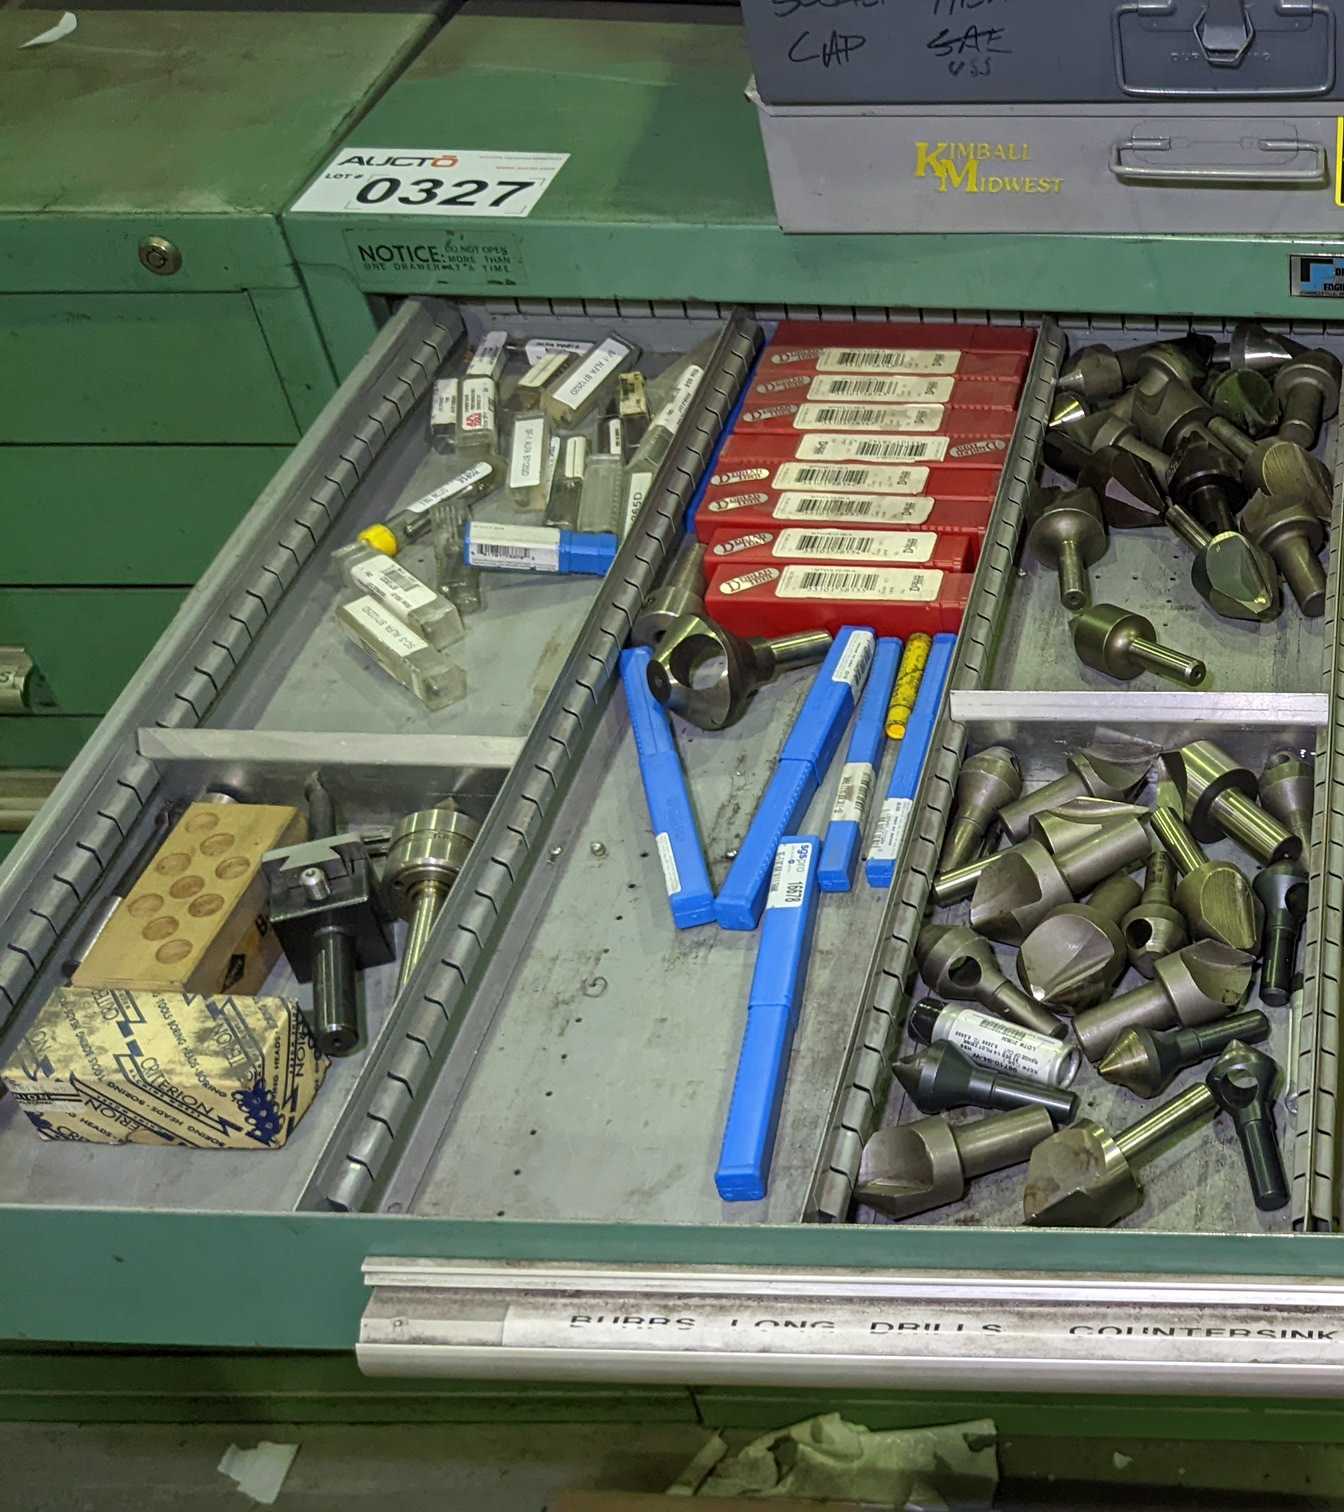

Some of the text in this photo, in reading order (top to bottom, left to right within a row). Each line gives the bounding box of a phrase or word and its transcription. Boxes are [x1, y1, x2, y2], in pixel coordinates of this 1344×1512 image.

[914, 142, 1031, 177] KIMBALL
[356, 177, 535, 207] 0327
[938, 159, 1065, 193] MIDWEST
[358, 245, 446, 263] NOTICE:
[482, 264, 510, 272] TIME
[141, 1057, 213, 1115] CRITERION
